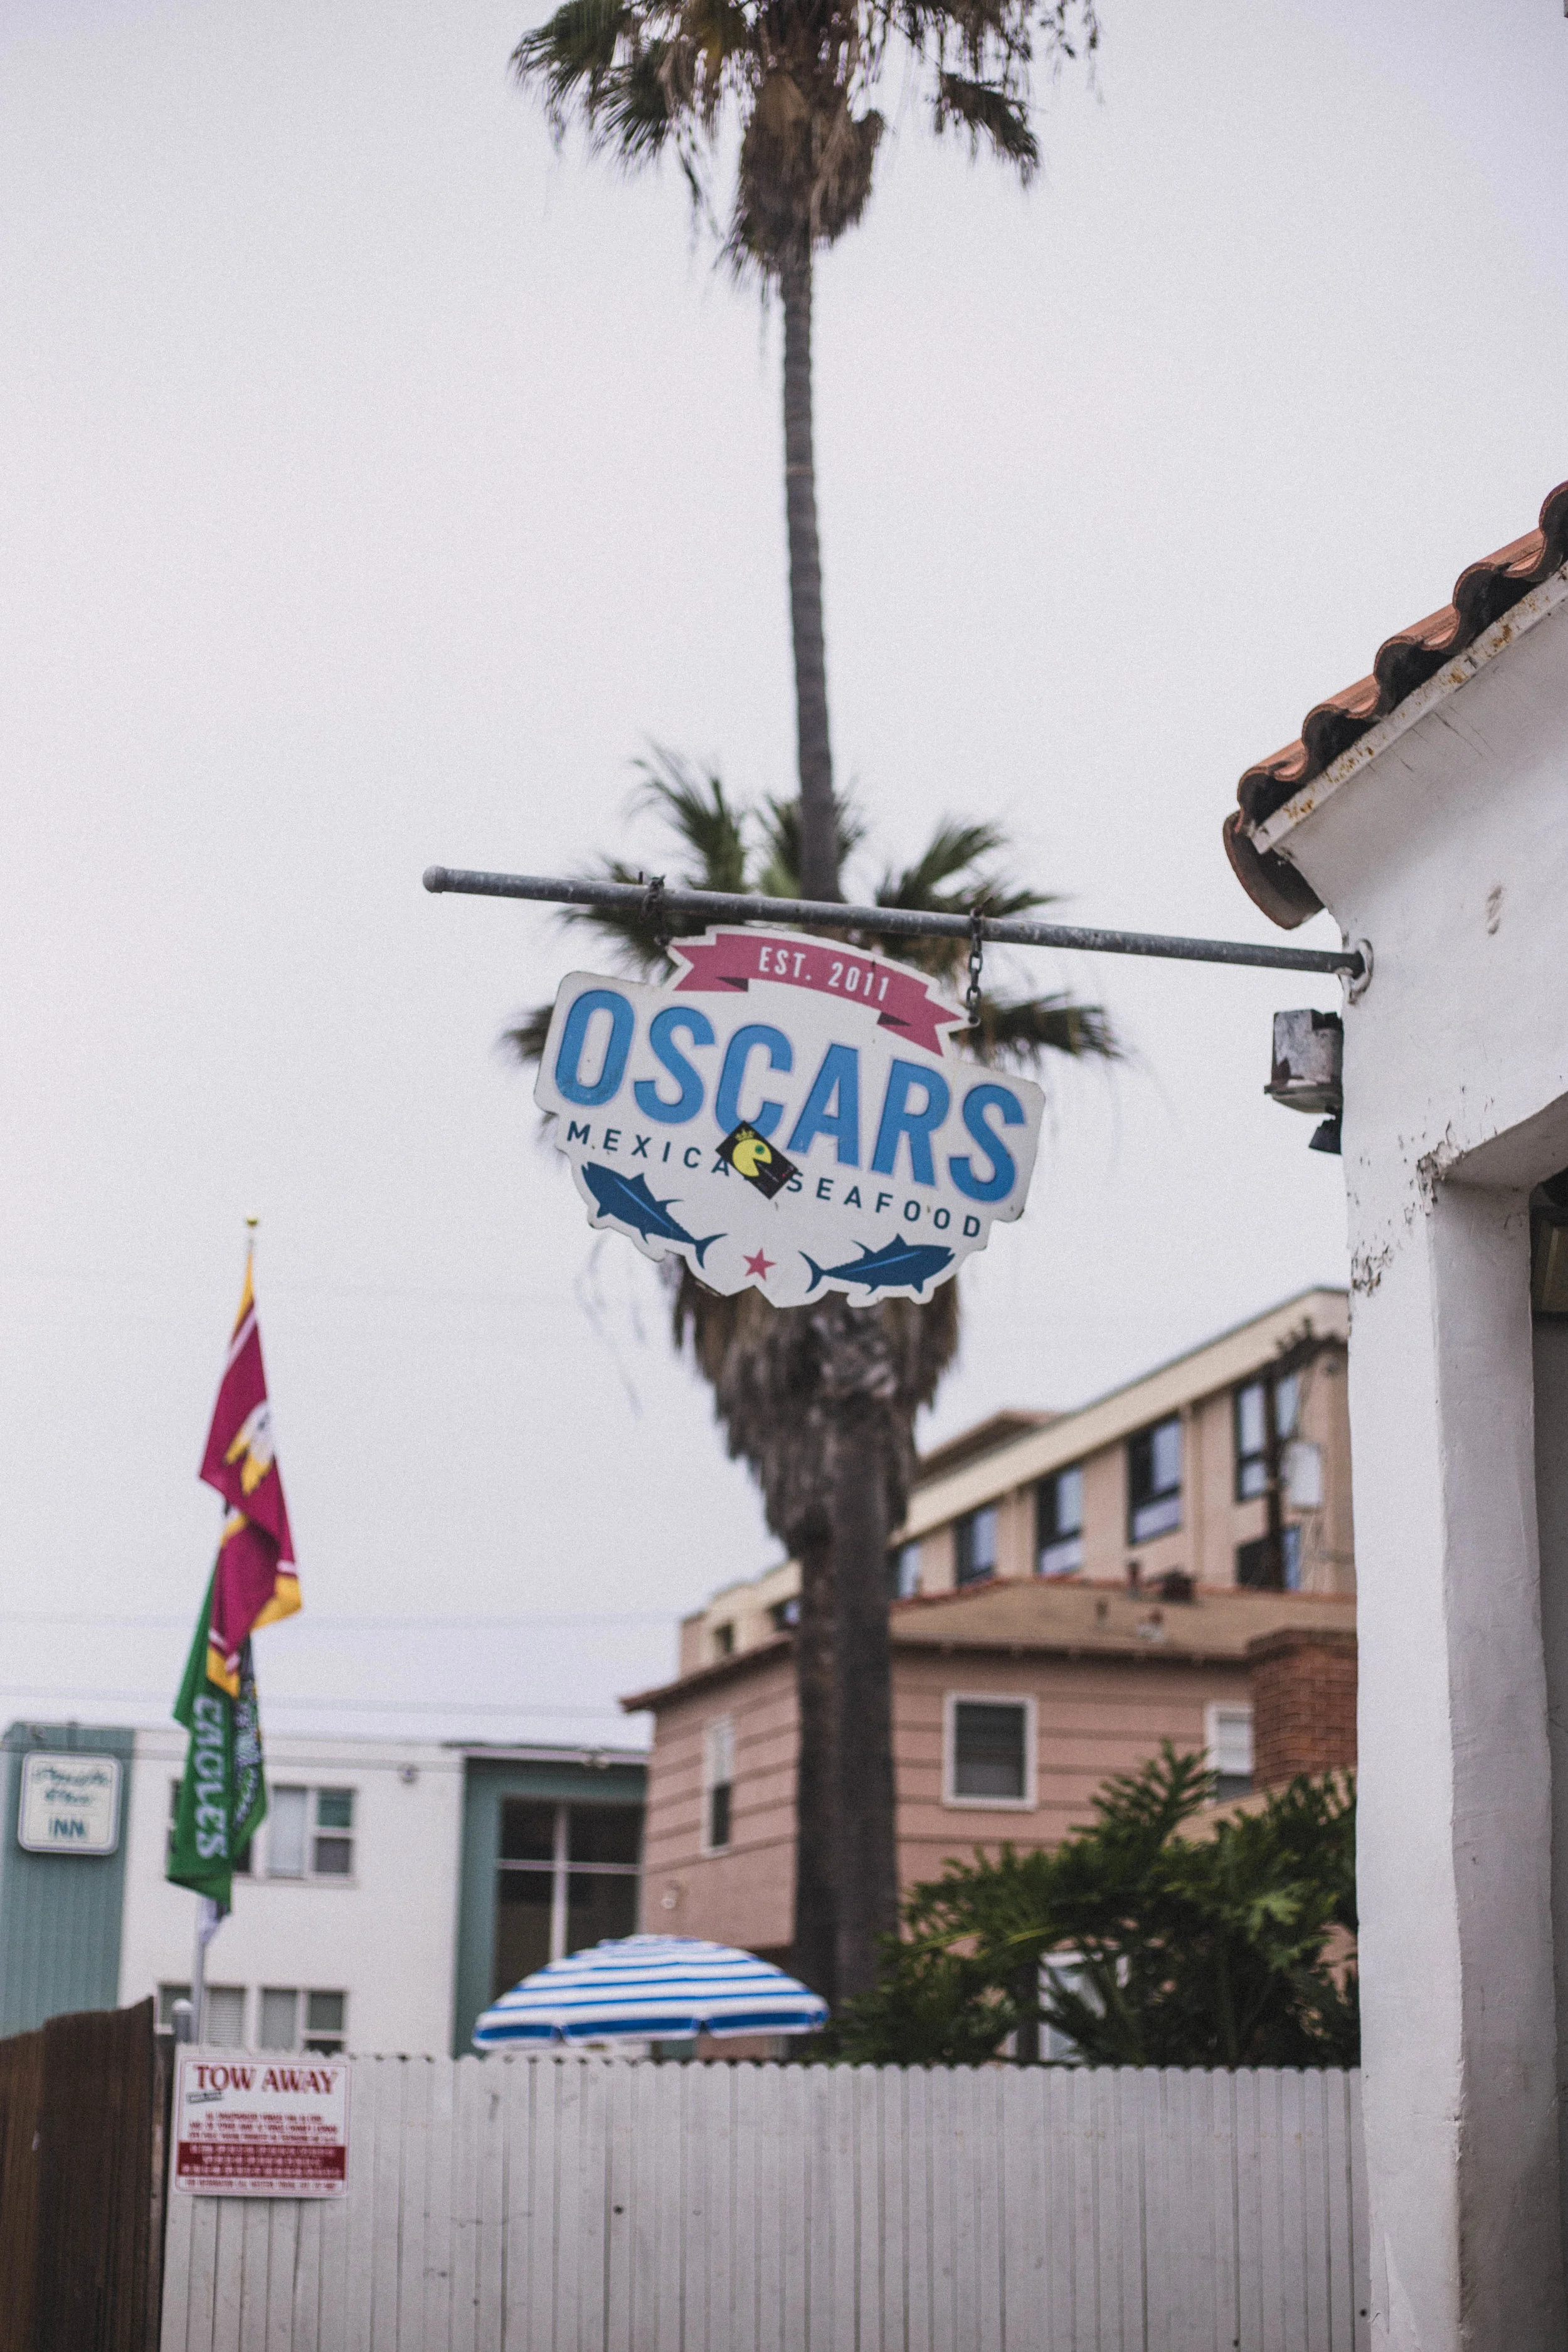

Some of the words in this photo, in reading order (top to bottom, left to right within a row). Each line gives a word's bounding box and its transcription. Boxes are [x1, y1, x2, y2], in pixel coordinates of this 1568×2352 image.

[758, 946, 811, 980] EST.
[829, 962, 890, 1001] 2011
[554, 989, 1025, 1202] OSCARS
[566, 1120, 747, 1181] MEXICA
[787, 1170, 981, 1237] SEAFOOD
[48, 1817, 86, 1838] INN
[195, 2064, 255, 2091] TOW
[262, 2067, 337, 2095] AWAY
